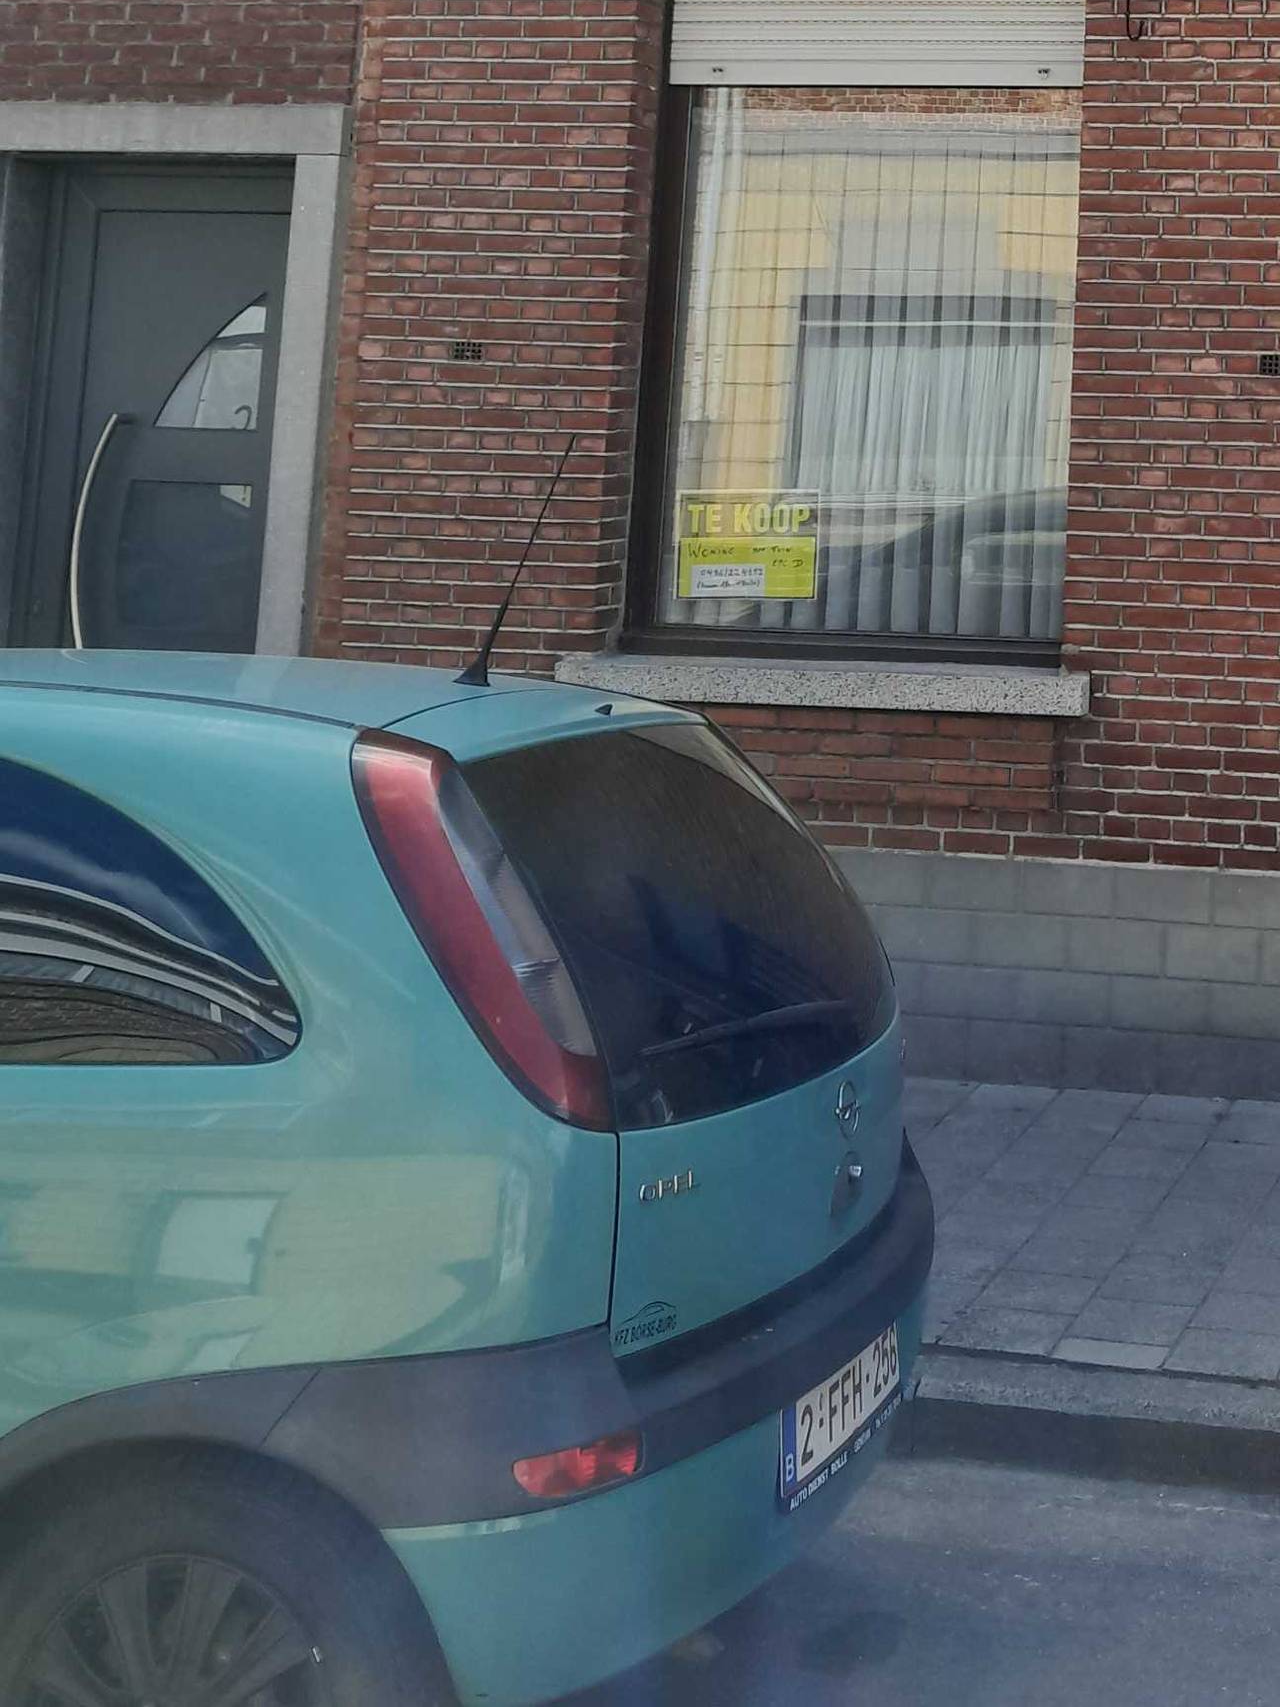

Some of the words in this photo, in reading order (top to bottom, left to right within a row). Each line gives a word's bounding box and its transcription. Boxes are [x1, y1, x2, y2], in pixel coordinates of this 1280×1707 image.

[687, 504, 723, 534] TE
[733, 502, 811, 534] KOOP
[639, 1170, 700, 1201] OPEL
[785, 1453, 795, 1483] B
